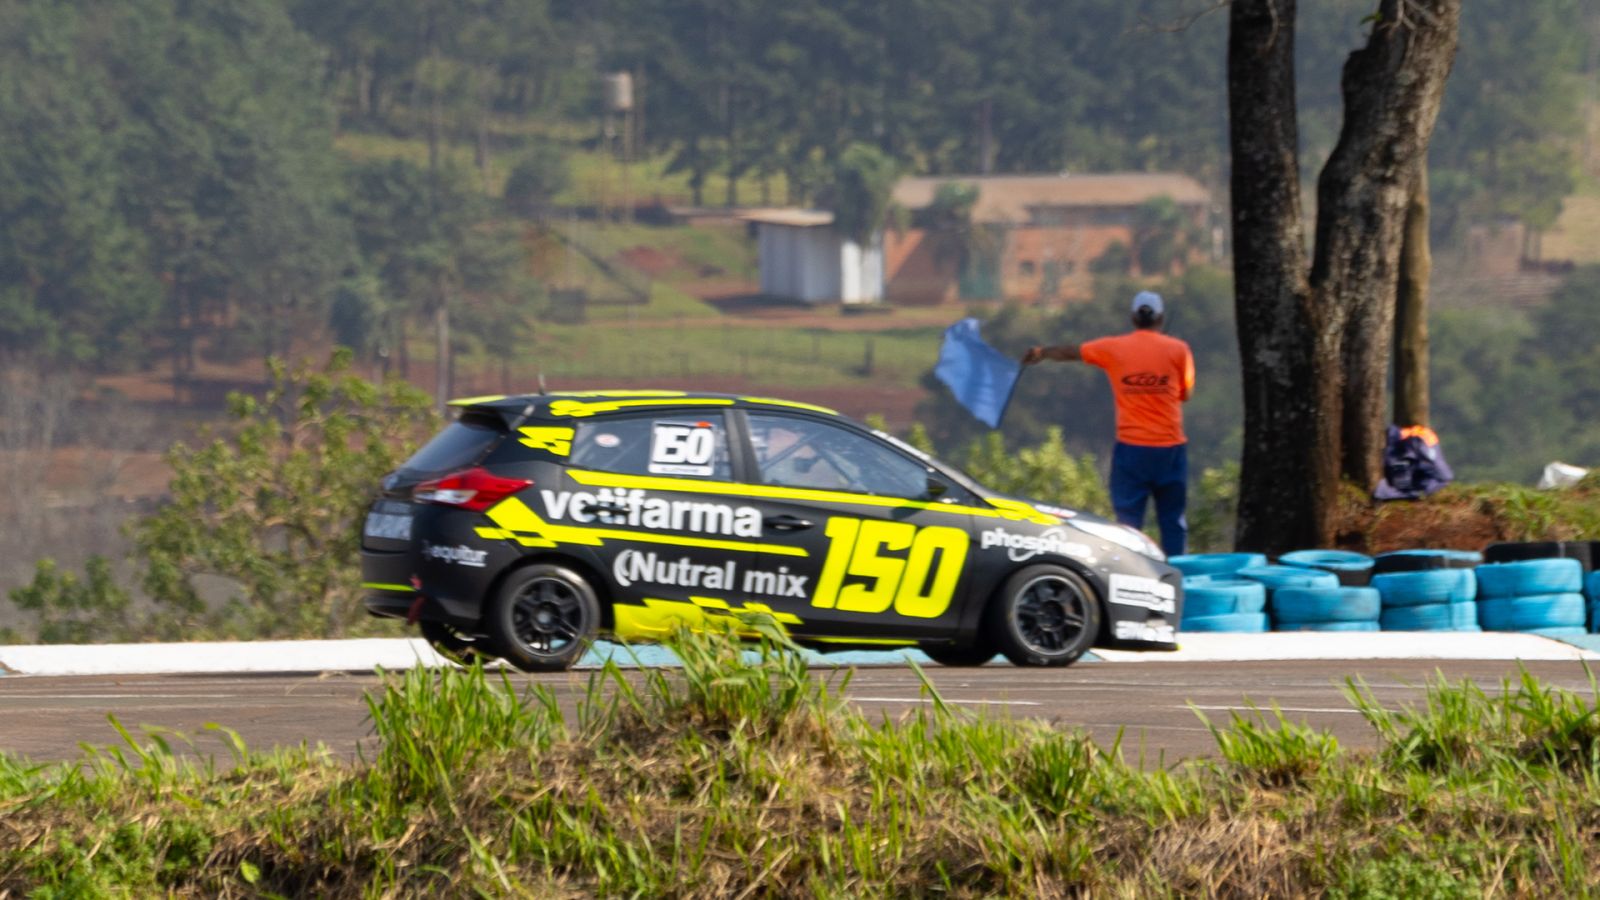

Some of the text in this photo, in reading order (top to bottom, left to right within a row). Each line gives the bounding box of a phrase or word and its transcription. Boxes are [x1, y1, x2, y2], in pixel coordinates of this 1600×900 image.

[652, 426, 714, 464] 150
[541, 487, 763, 537] vetifarma
[630, 551, 808, 598] Nutral mix
[811, 517, 968, 618] 150
